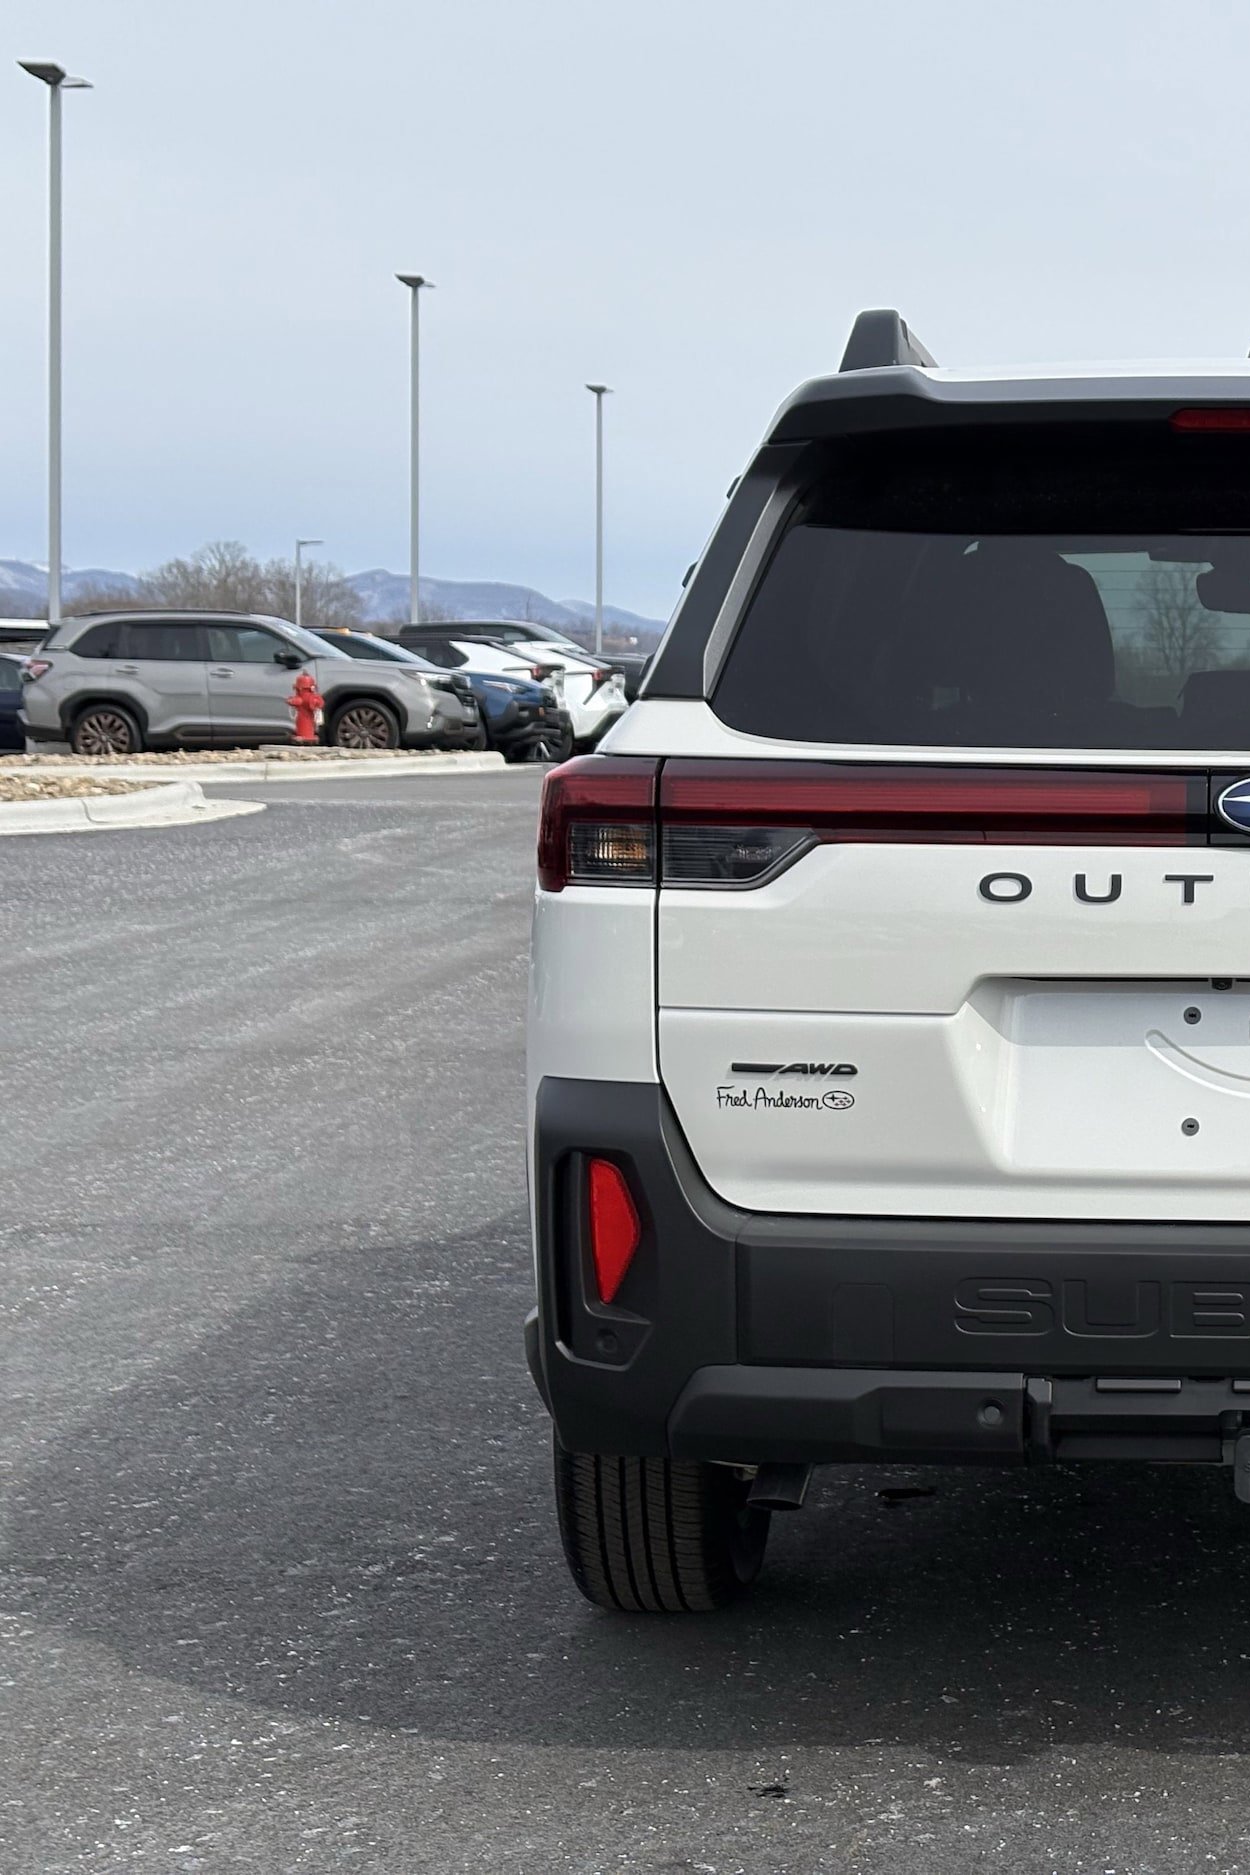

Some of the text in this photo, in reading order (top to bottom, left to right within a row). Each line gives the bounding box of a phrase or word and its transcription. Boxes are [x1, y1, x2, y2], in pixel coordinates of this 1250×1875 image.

[778, 1062, 858, 1076] AWD
[716, 1085, 823, 1110] Fred Anderson
